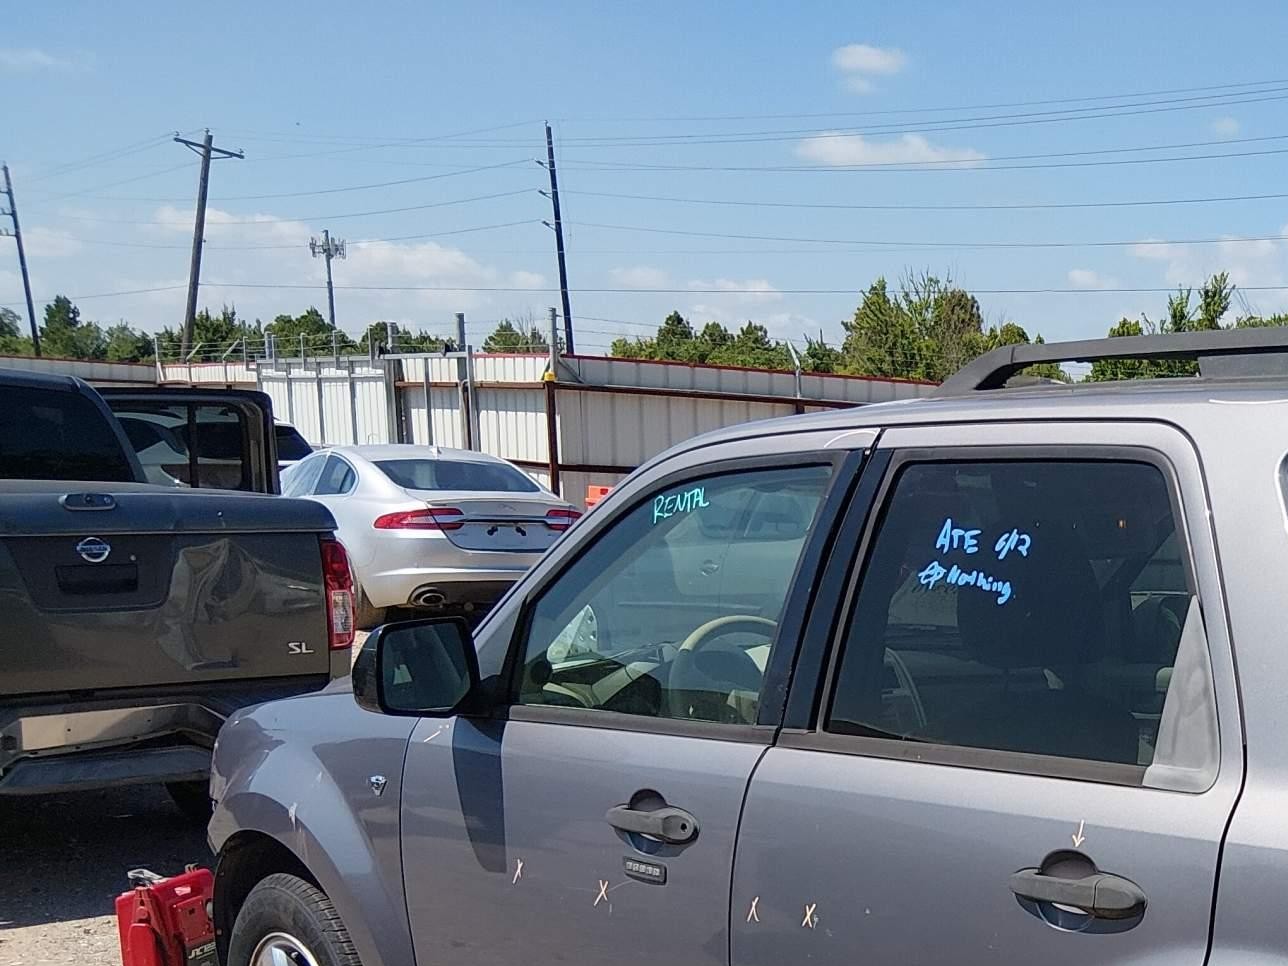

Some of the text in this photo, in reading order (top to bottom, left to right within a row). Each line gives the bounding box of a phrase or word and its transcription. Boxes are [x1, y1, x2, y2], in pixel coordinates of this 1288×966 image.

[653, 487, 710, 524] RENTAL
[935, 518, 982, 554] ATE
[288, 642, 315, 655] SL
